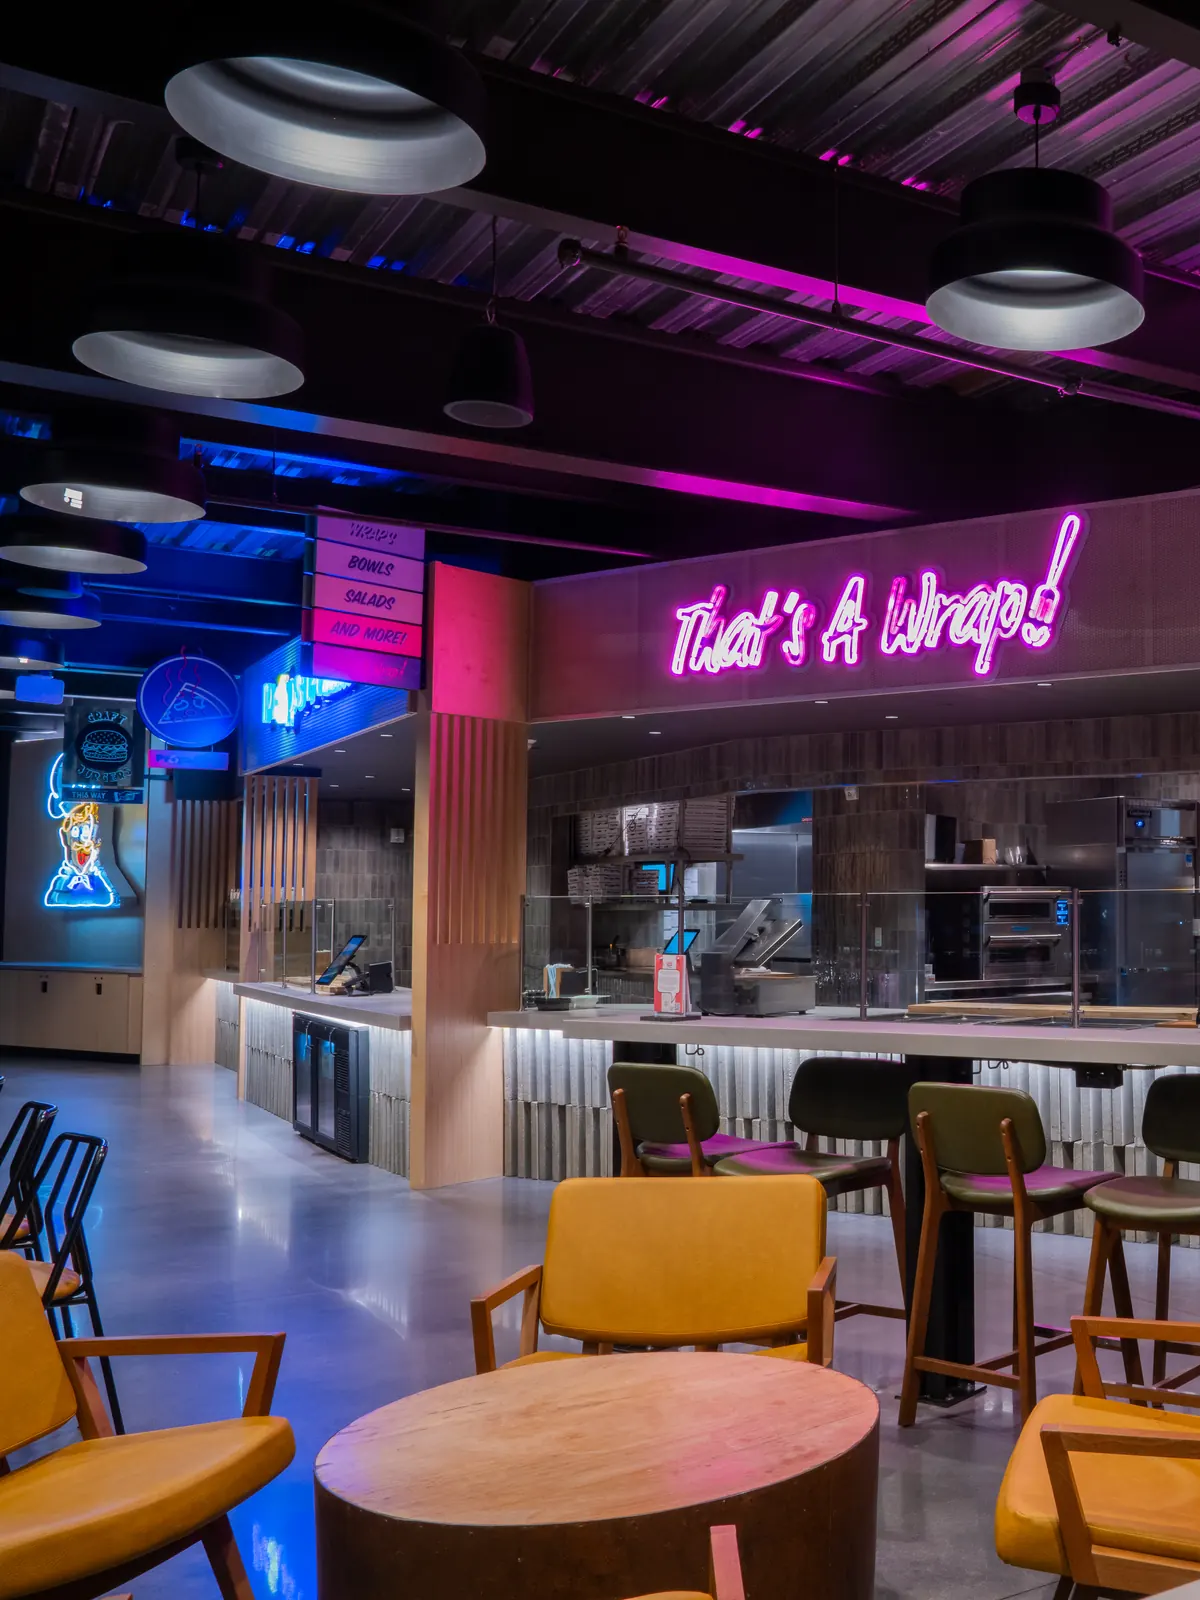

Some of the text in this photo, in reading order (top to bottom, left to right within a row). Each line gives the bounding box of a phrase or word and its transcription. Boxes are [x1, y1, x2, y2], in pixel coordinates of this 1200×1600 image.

[349, 522, 397, 545] WRAPS
[347, 555, 395, 577] BOWLS
[344, 588, 396, 611] SALADS
[330, 620, 408, 646] AND MORE!
[671, 584, 816, 675] That's
[821, 576, 869, 665] A
[71, 791, 107, 800] THIS WAY
